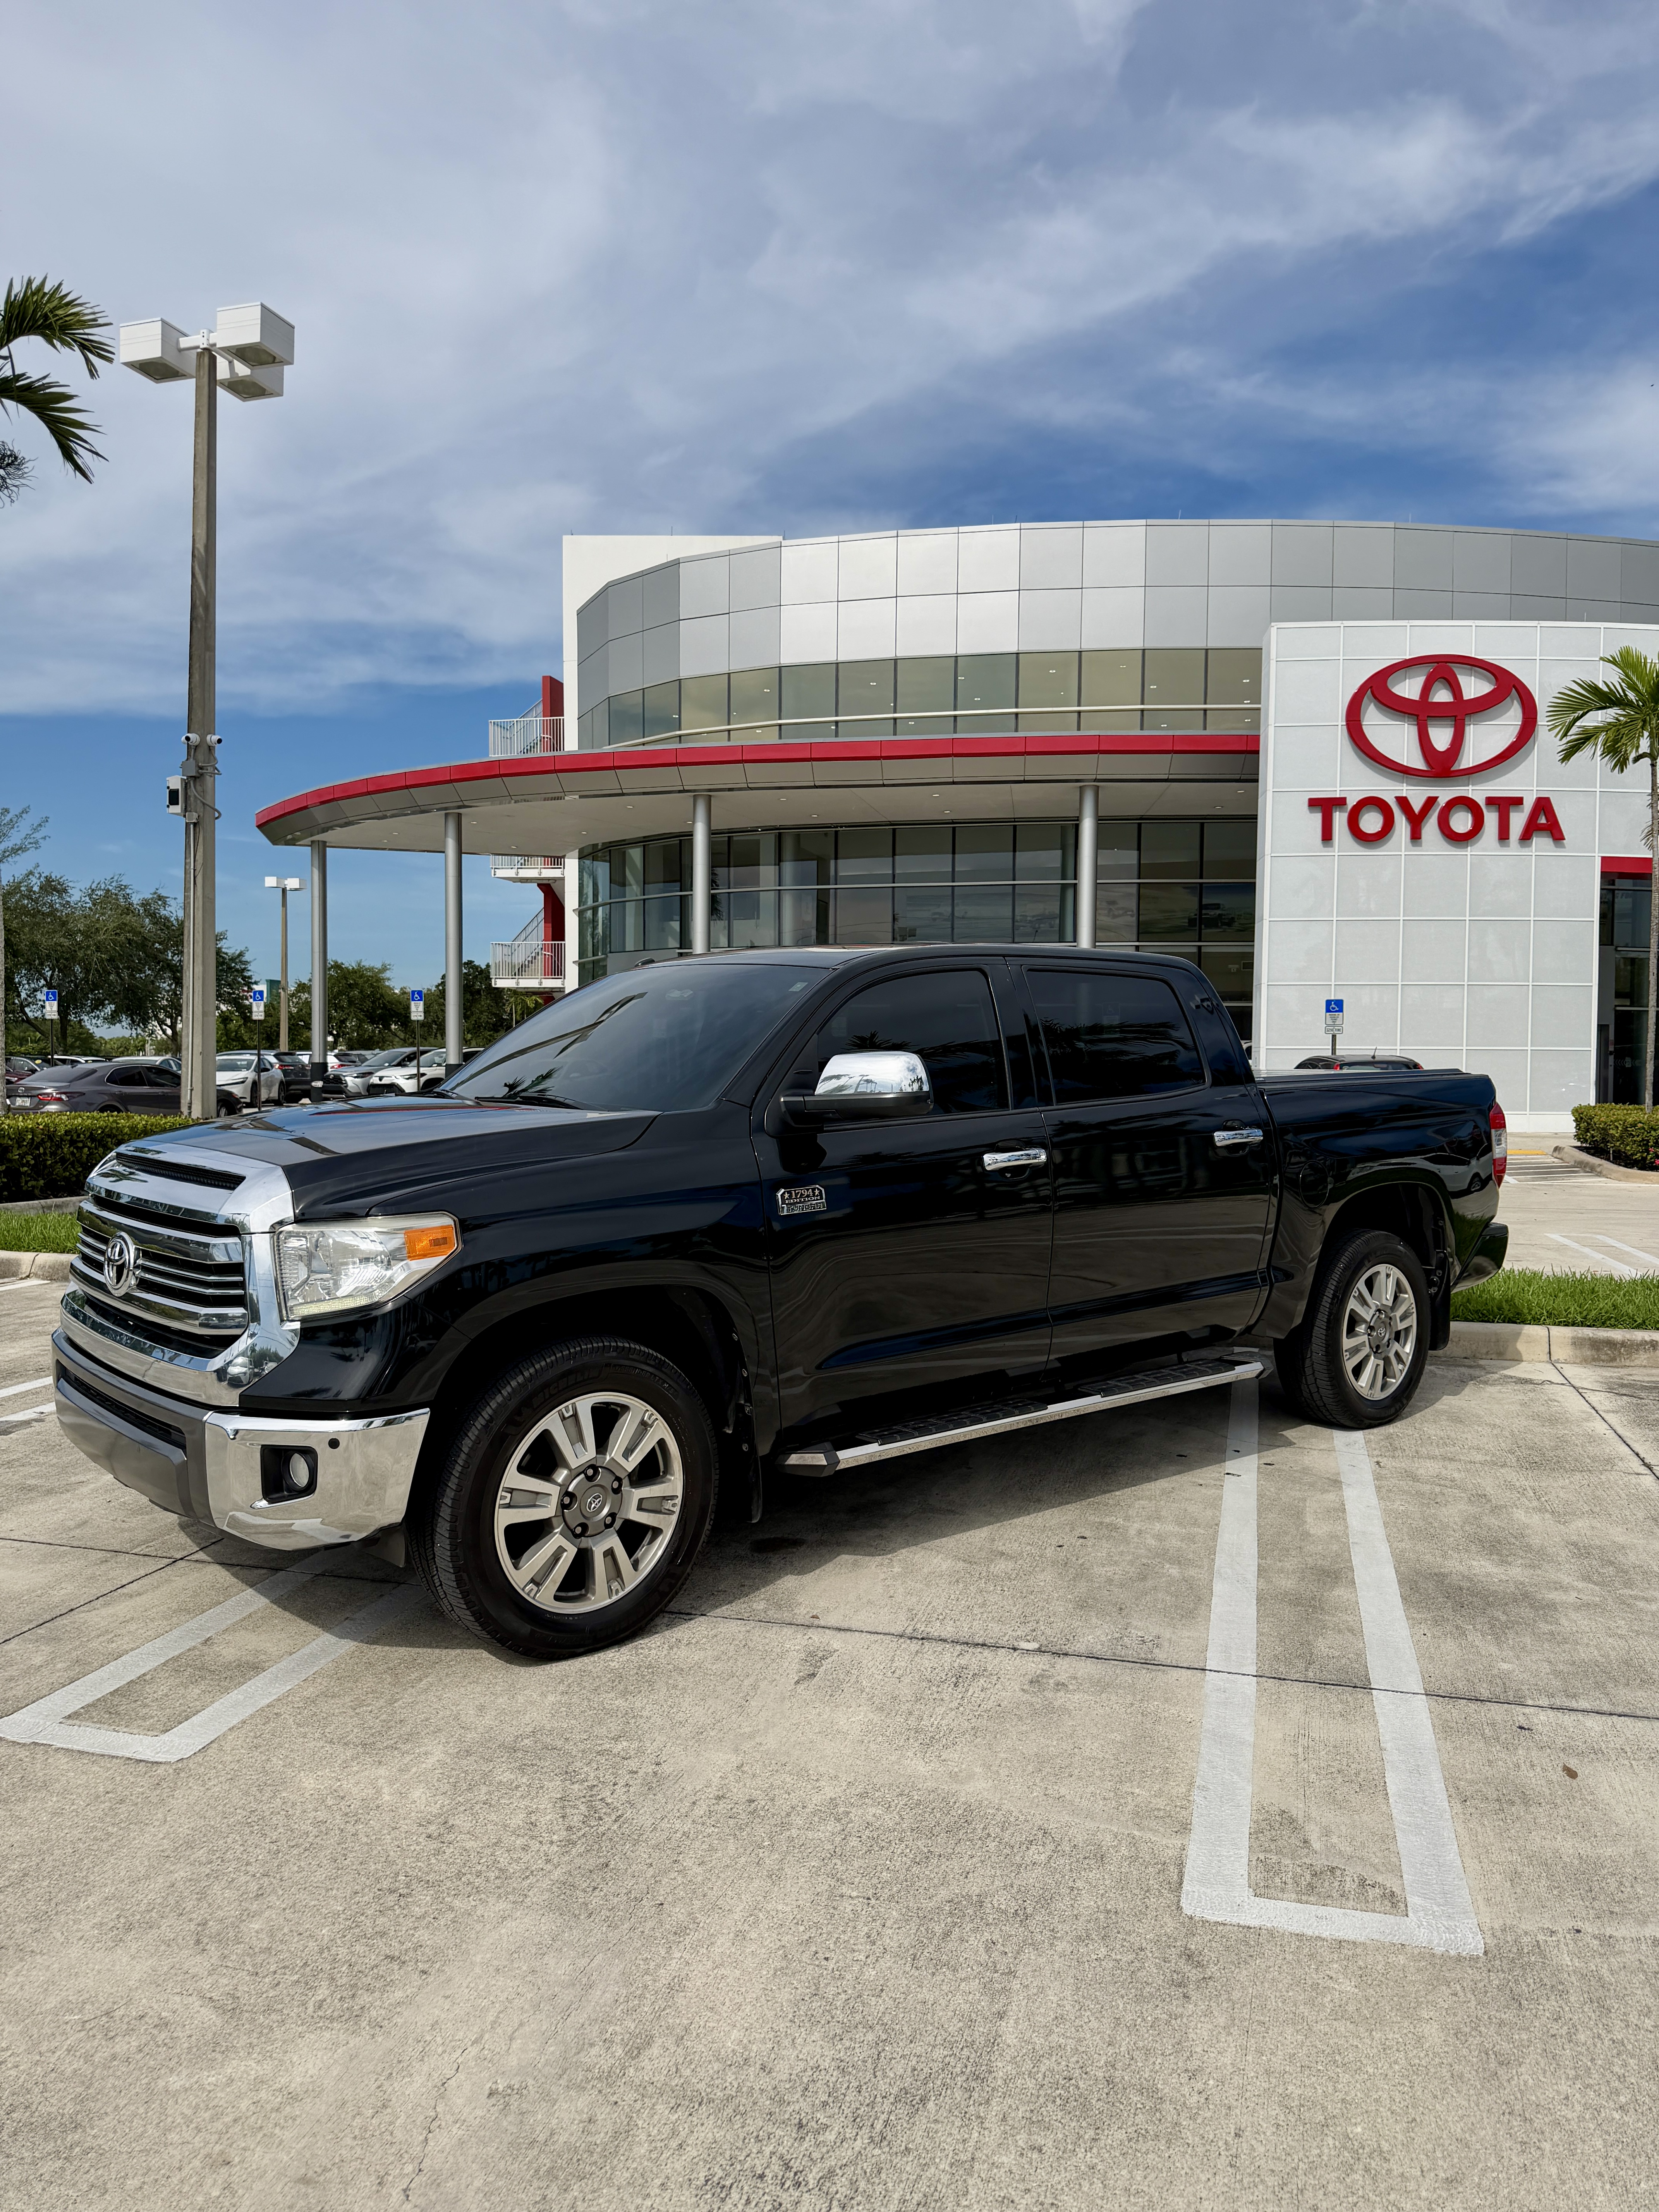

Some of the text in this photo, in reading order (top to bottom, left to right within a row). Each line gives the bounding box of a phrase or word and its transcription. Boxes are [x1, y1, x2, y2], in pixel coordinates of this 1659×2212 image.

[1308, 796, 1566, 842] TOYOTA
[791, 1189, 813, 1198] 1794
[787, 1203, 823, 1212] TUNDRA
